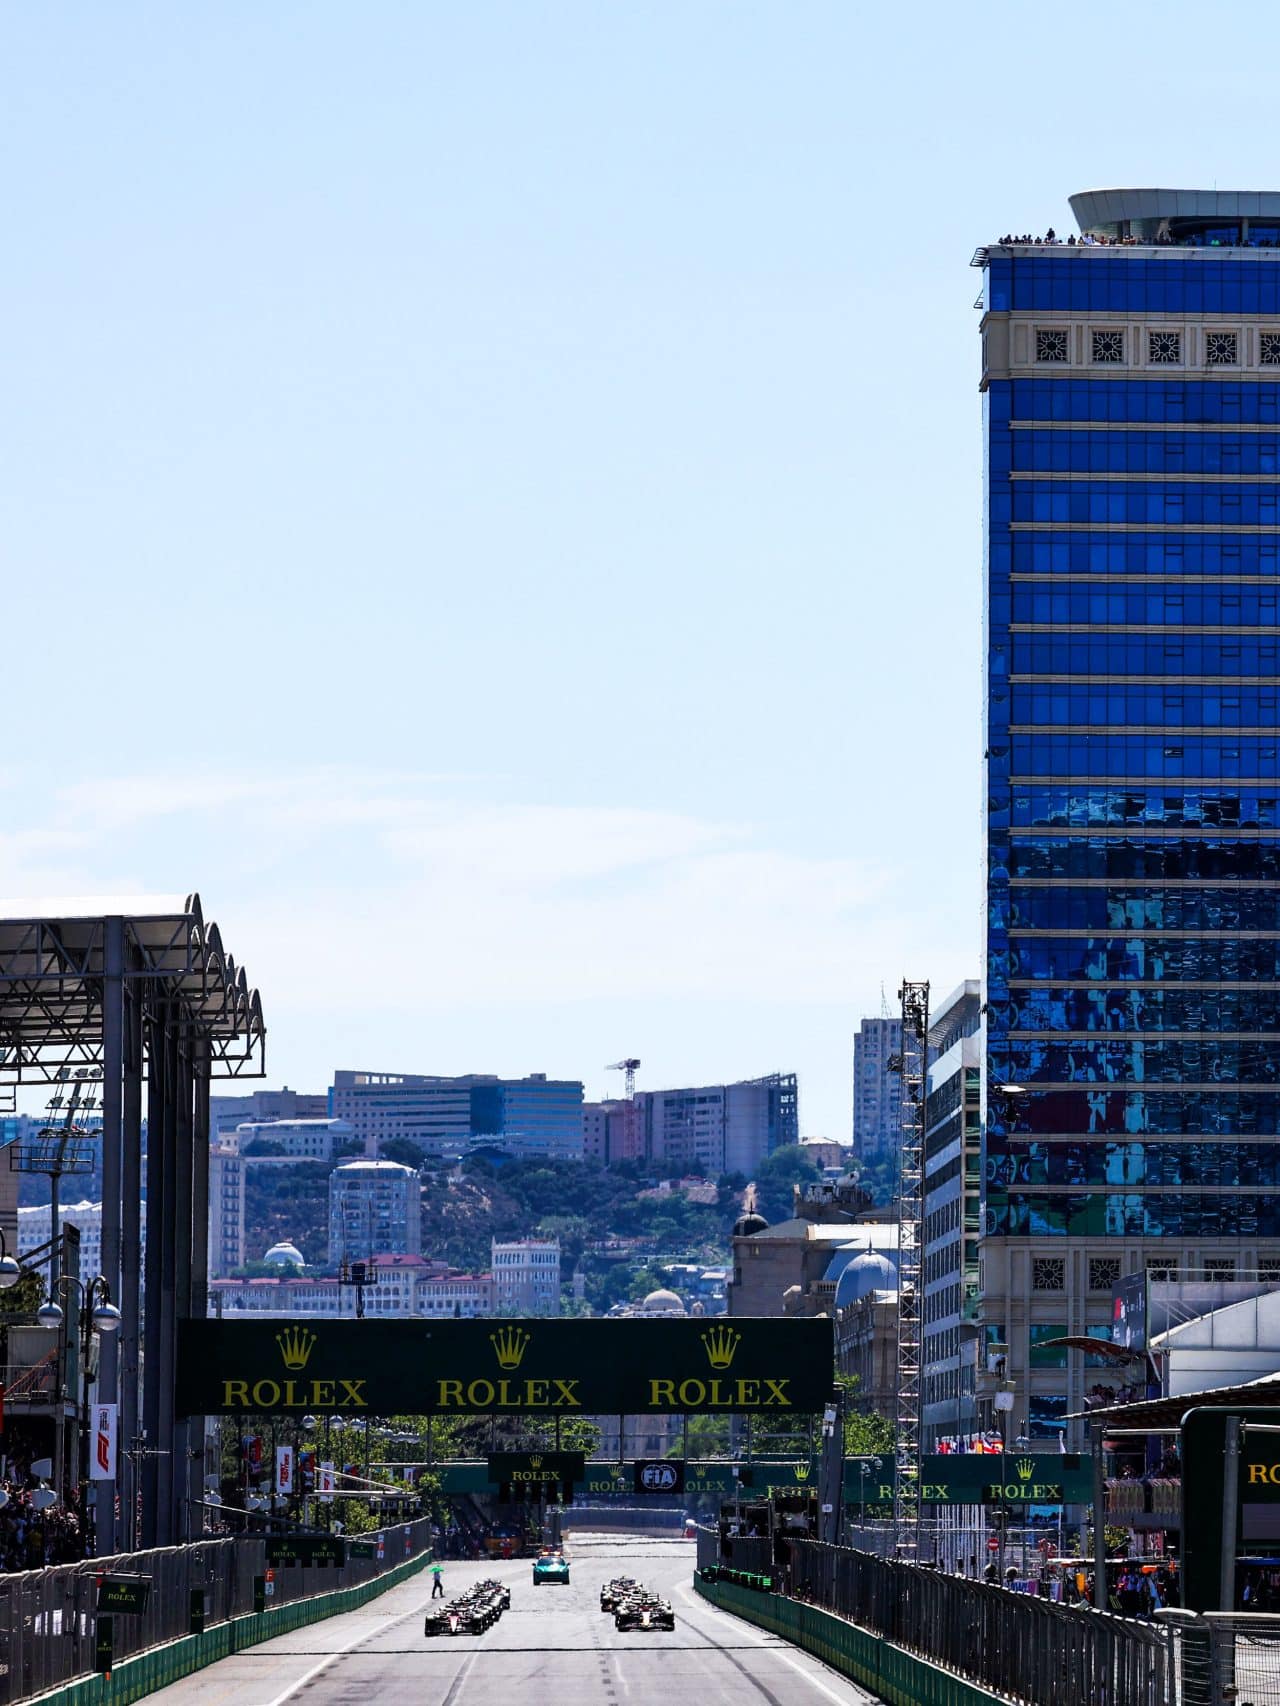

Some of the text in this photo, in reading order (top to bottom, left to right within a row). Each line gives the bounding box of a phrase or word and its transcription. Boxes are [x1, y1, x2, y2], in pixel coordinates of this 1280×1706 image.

[221, 1380, 368, 1407] ROLEX
[437, 1380, 582, 1406] ROLEX
[648, 1379, 792, 1406] ROLEX
[512, 1471, 560, 1481] ROLEX
[643, 1470, 673, 1484] FIA
[990, 1484, 1061, 1499] ROLEX
[108, 1592, 136, 1602] ROLEX
